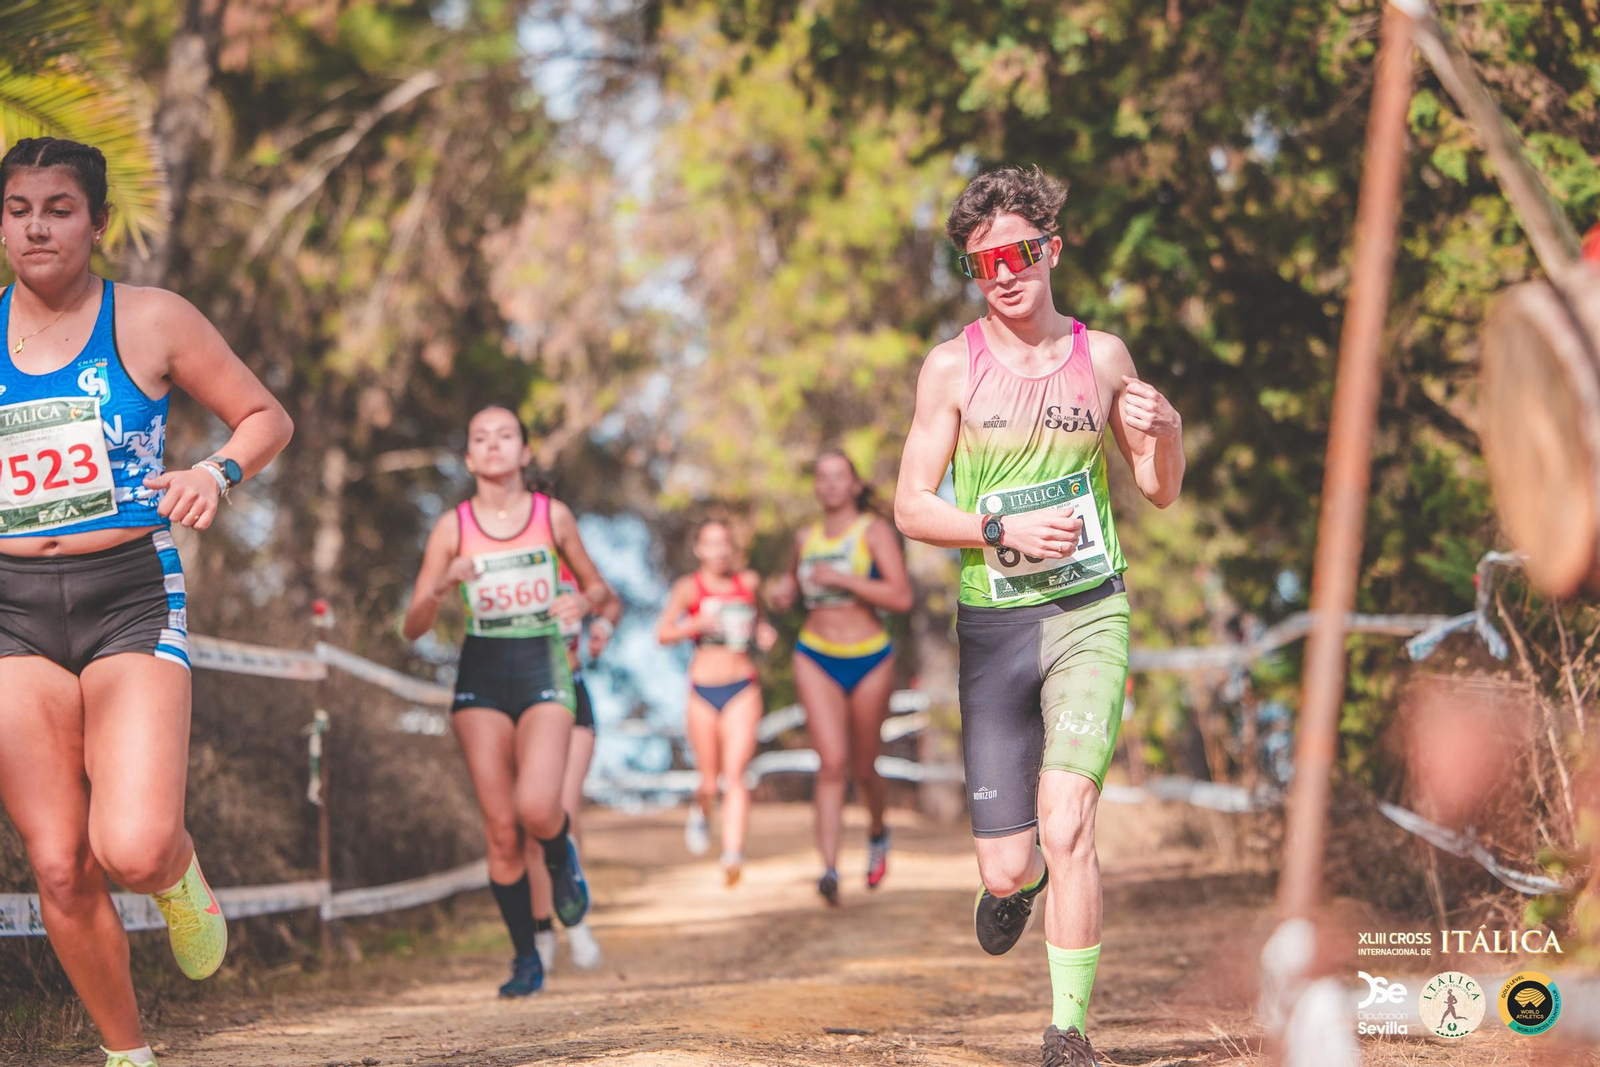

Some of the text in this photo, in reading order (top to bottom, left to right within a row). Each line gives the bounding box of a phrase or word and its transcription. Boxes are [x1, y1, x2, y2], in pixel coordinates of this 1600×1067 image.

[983, 419, 1008, 429] HORIZON
[1045, 405, 1097, 433] SJA
[0, 443, 99, 497] 523
[1010, 484, 1066, 507] ITÁLICA
[476, 577, 550, 612] 5560
[1055, 710, 1108, 745] SJA
